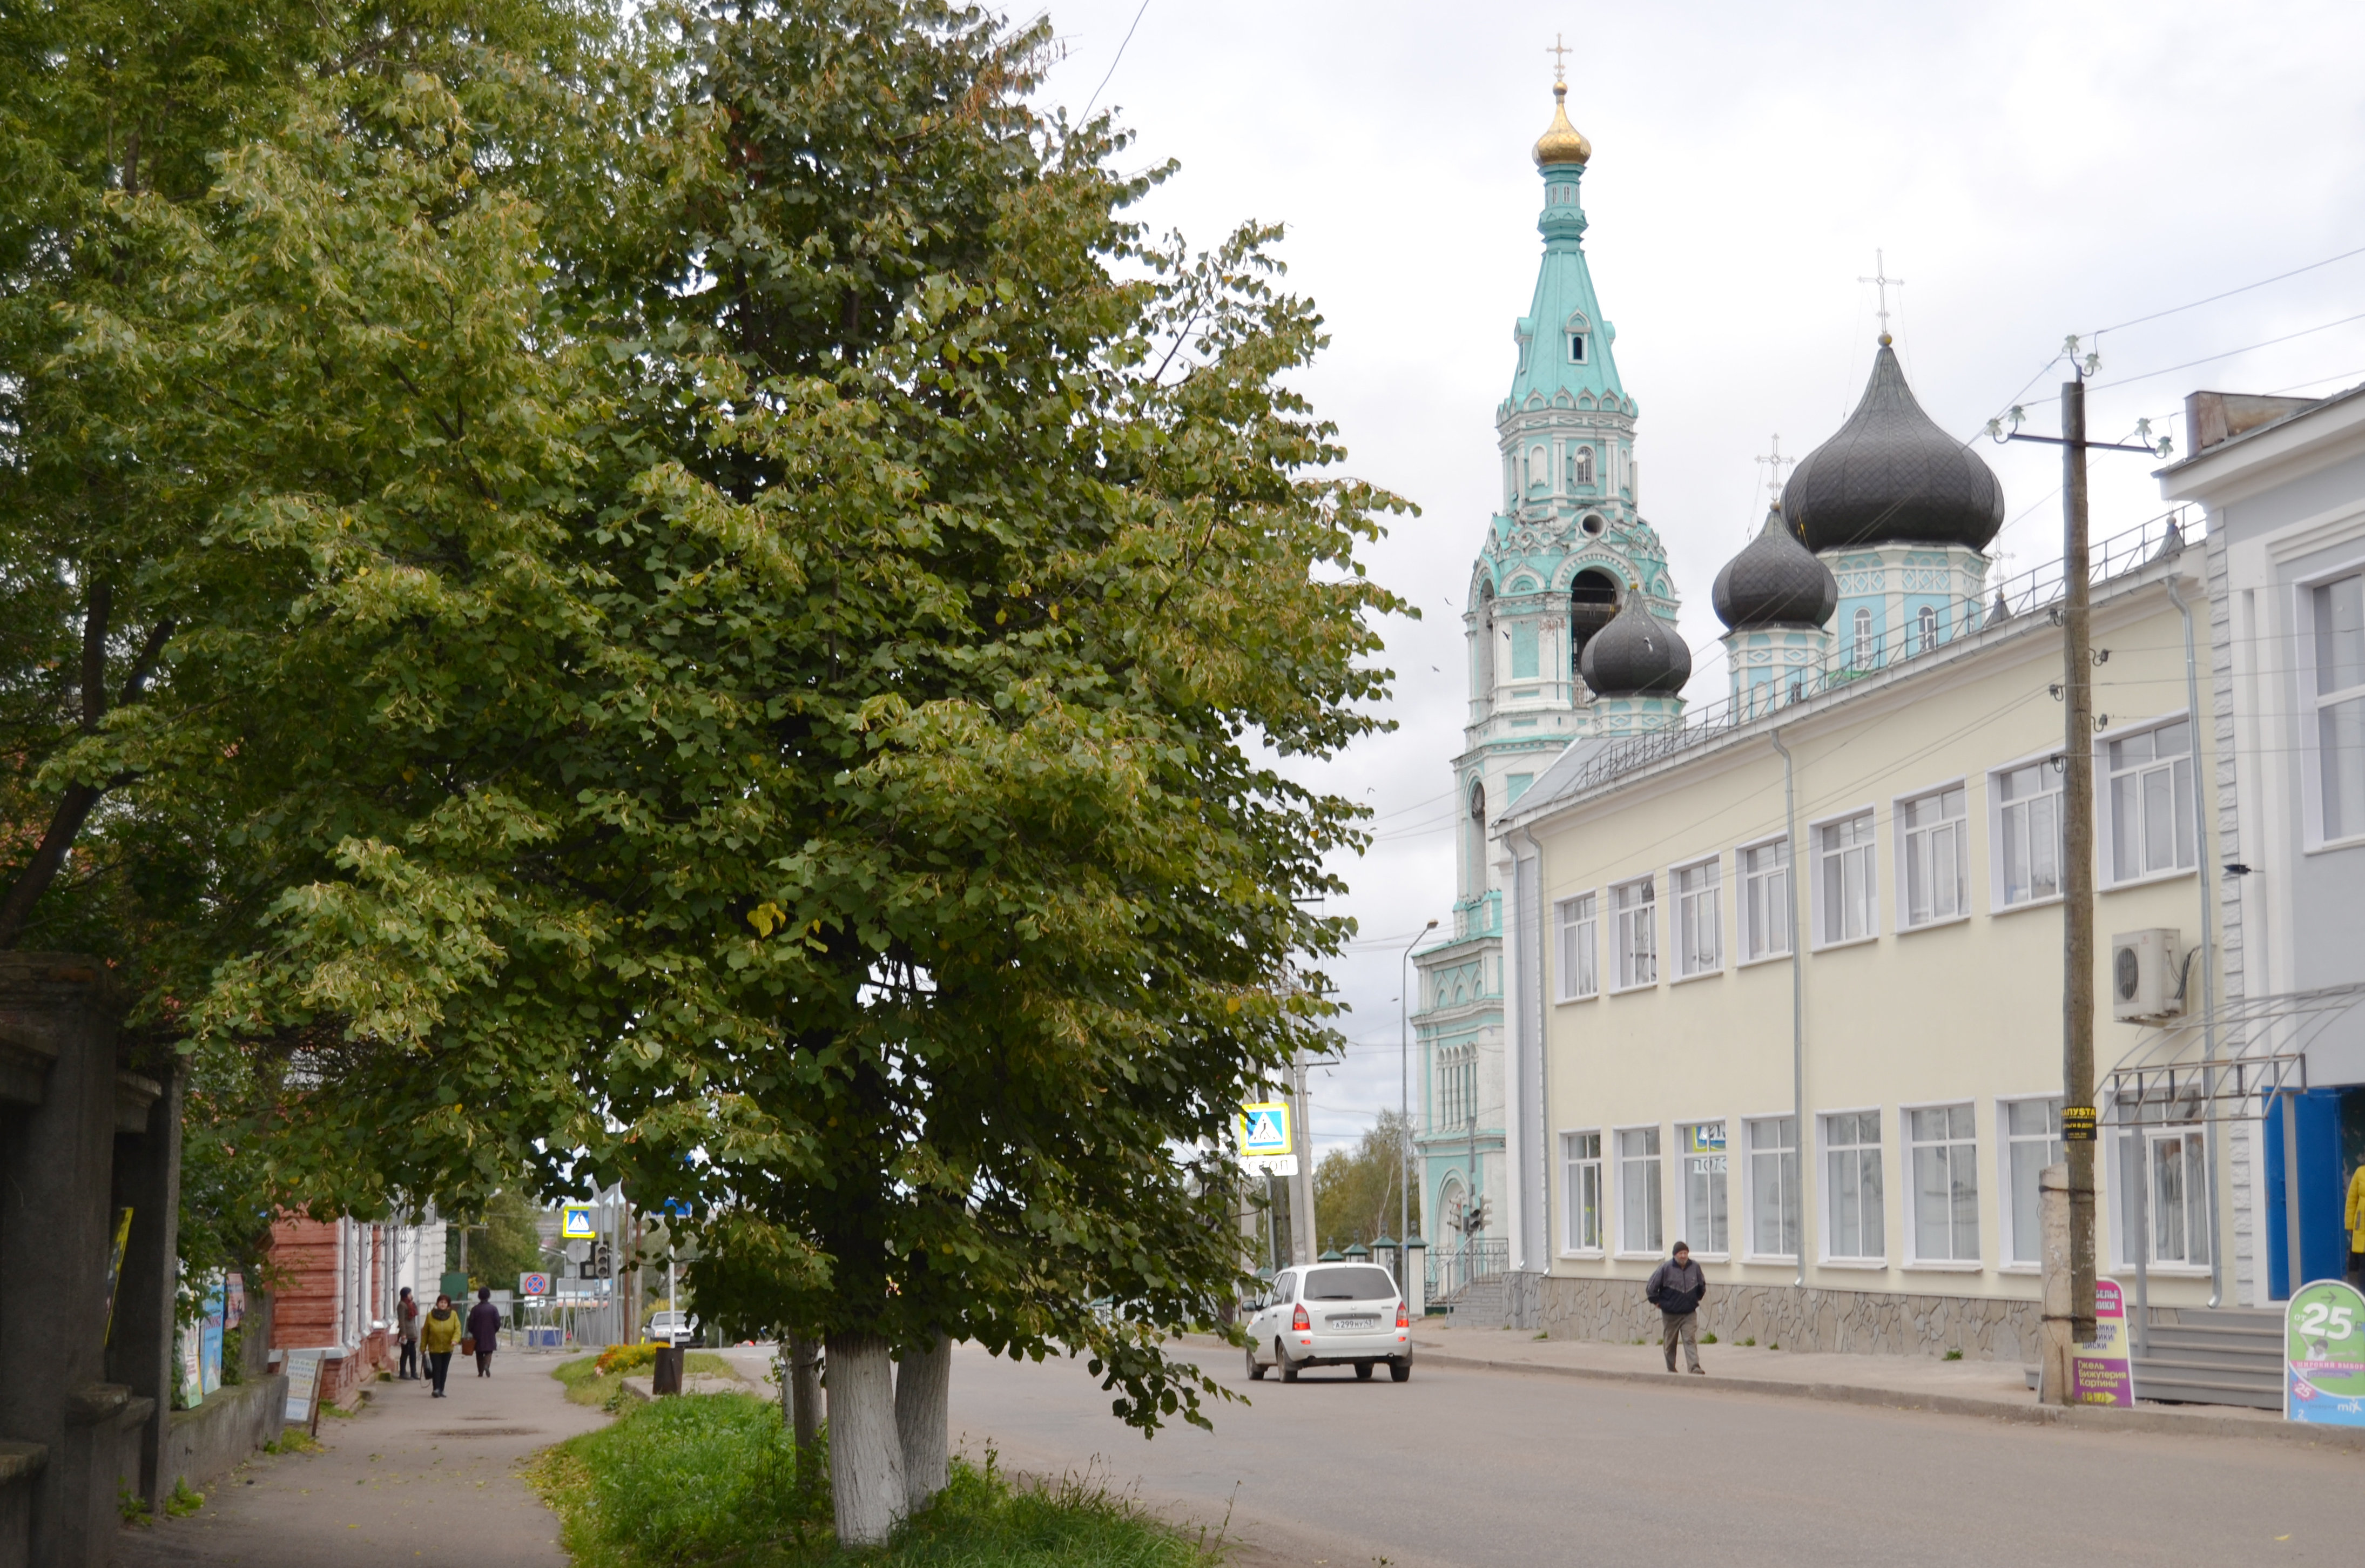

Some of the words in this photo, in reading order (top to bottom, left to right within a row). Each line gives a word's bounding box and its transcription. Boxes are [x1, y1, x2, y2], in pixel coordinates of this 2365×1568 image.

[1249, 1160, 1288, 1172] СТОП
[2299, 1302, 2353, 1341] 25
[2078, 1369, 2126, 1380] Бижутерия
[2079, 1378, 2118, 1388] Картины
[2294, 1383, 2312, 1397] 25
